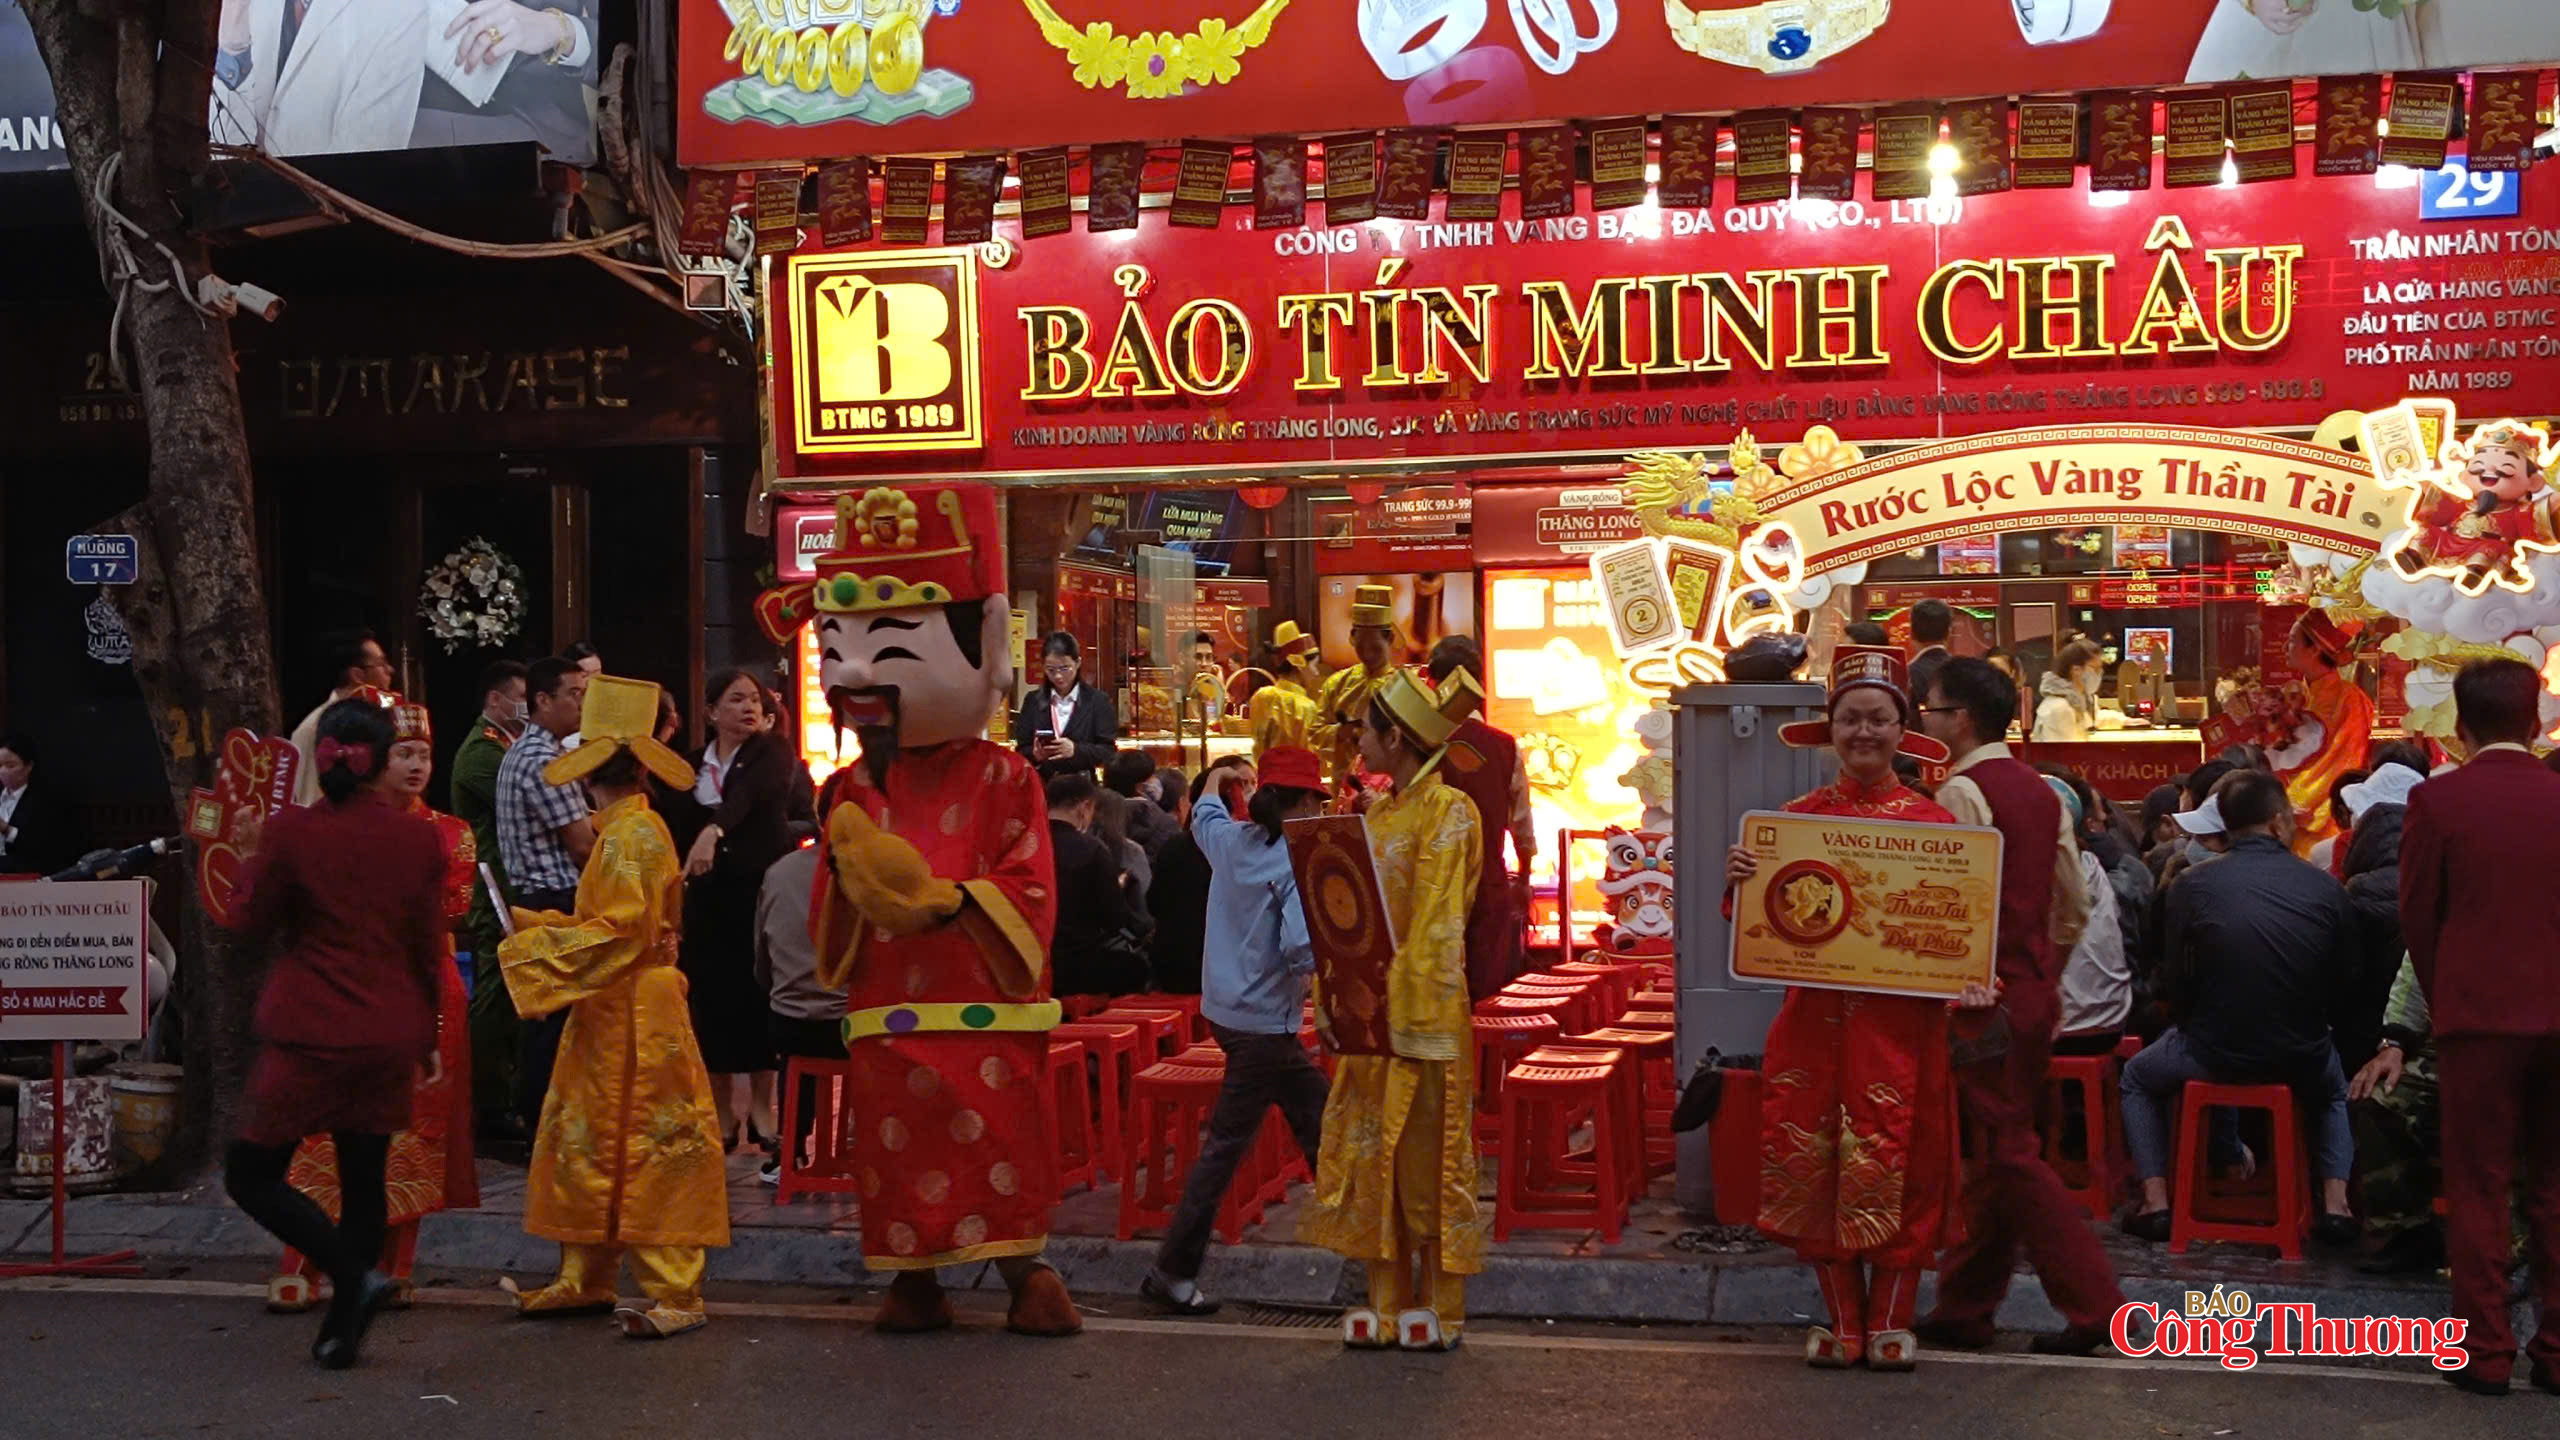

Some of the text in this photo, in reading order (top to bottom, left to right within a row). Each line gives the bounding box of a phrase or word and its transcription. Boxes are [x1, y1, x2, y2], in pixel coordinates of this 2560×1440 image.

[2436, 163, 2504, 208] 29
[1275, 225, 1358, 256] CÔNG
[1415, 221, 1494, 248] TNHH
[2350, 229, 2420, 260] TRẦN
[2425, 230, 2499, 257] NHÂN
[2363, 281, 2392, 304] LÀ
[2394, 278, 2435, 303] CỬA
[1018, 215, 2304, 400] BẢO TÍN MINH CHÂU
[2343, 308, 2555, 335] ĐẦU TIÊN CỦA BTMC
[2345, 340, 2390, 365] PHỐ
[2391, 338, 2450, 361] TRẦN
[2454, 338, 2516, 360] NHÂN
[2408, 369, 2513, 391] NĂM 1989
[820, 404, 954, 430] BTMC 1989
[1013, 424, 1056, 447] KINH
[1059, 424, 1127, 446] DOANH
[1132, 420, 1185, 443] VÀNG
[1191, 417, 1245, 441] RỒNG
[1253, 416, 1318, 439] THĂNG
[1324, 417, 1384, 440] LONG,
[1390, 415, 1424, 436] SJC
[1432, 409, 1457, 433] VÀ
[1465, 408, 1519, 432] VÀNG
[1527, 408, 1593, 431] TRANG
[1599, 402, 1638, 428] SỨC
[1644, 402, 1675, 425] MỸ
[1681, 399, 1738, 427] NGHỆ
[1745, 394, 1797, 423] CHẤT
[1804, 395, 1848, 422] LIỆU
[1857, 389, 1914, 417] BẰNG
[1924, 387, 1980, 415] VÀNG
[2053, 382, 2129, 409] THĂNG
[2136, 384, 2198, 407] LONG
[1384, 501, 1415, 513] TRANG
[1416, 498, 1434, 511] SỨC
[1563, 494, 1590, 504] VÀNG
[1821, 455, 2358, 538] Rước Lộc Vàng Thần Tài
[1539, 513, 1641, 530] THĂNG LONG
[90, 563, 117, 577] 17
[1636, 609, 1648, 622] 2
[2100, 761, 2170, 781] KHÁCH
[1822, 830, 1966, 855] VÀNG LINH GIÁP
[31, 903, 51, 916] TÍN
[55, 904, 90, 916] MINH
[94, 901, 131, 915] CHÂU
[17, 932, 133, 949] ĐI ĐẾN ĐIỂM MUA, BÁN
[14, 954, 134, 970] RỒNG THĂNG LONG
[2, 991, 20, 1009] SỐ
[23, 998, 30, 1008] 4
[33, 996, 56, 1008] MAI
[59, 991, 86, 1008] HẮC
